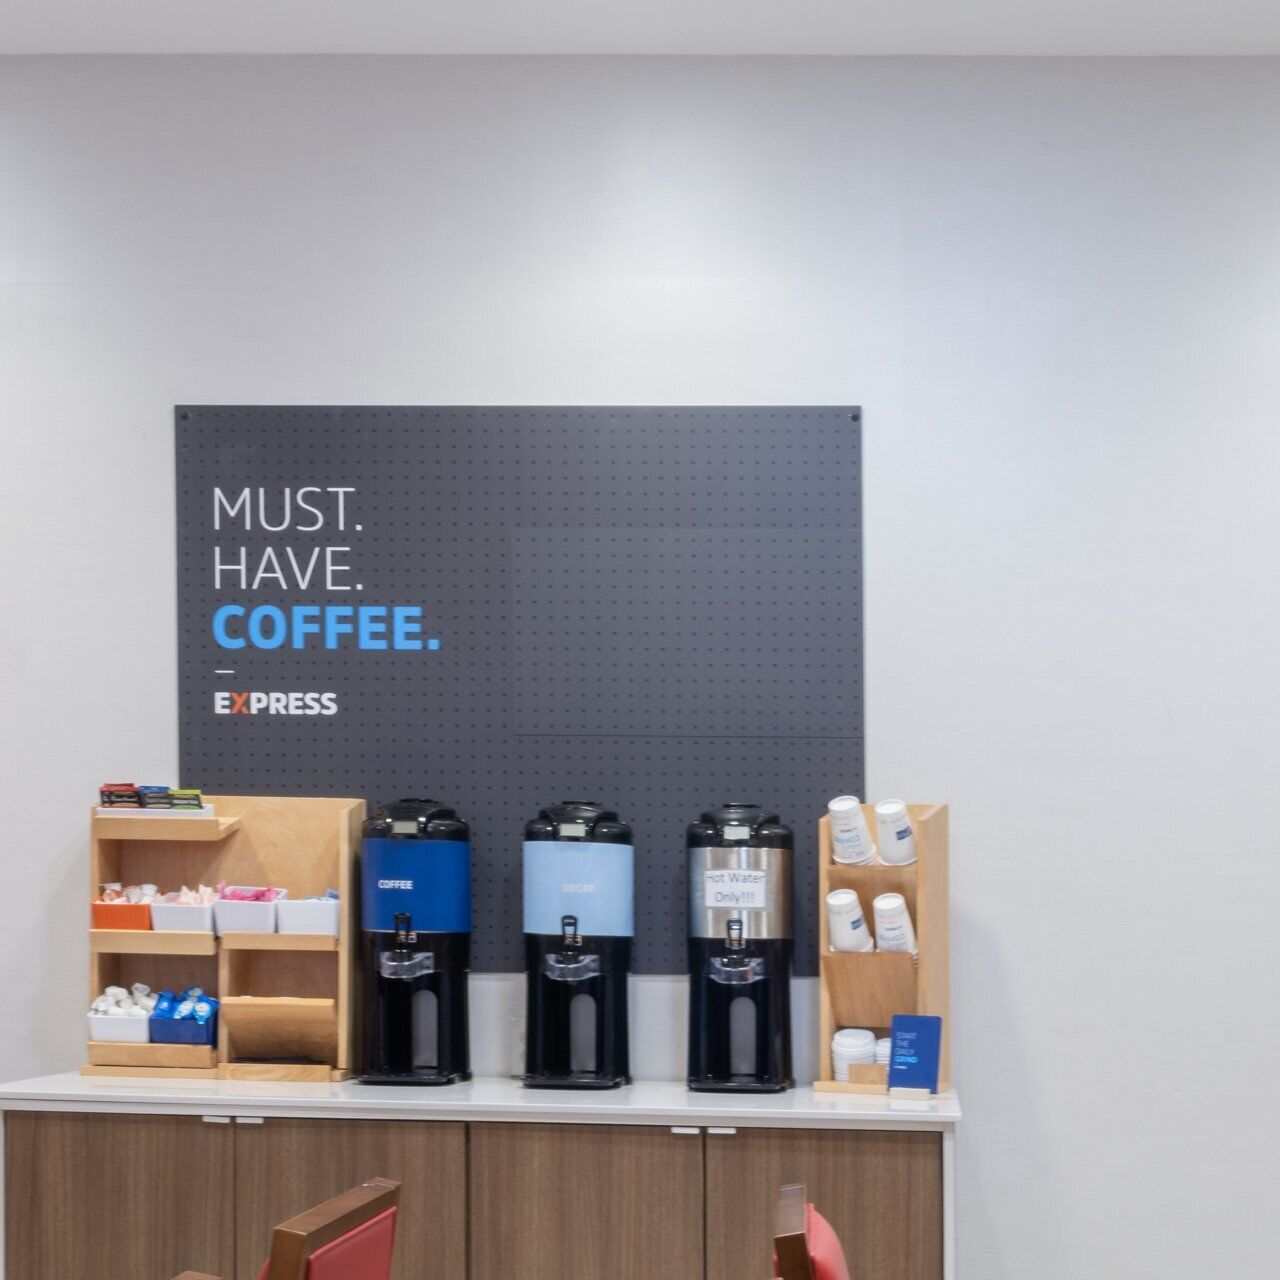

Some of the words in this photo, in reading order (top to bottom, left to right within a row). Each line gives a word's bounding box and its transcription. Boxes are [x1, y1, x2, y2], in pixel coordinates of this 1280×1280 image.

[213, 486, 363, 532] MUST.
[214, 546, 364, 590] HAVE.
[212, 604, 440, 650] COFFEE.
[214, 691, 338, 715] EXPRESS
[377, 879, 414, 889] COFFEE
[729, 873, 766, 884] Water
